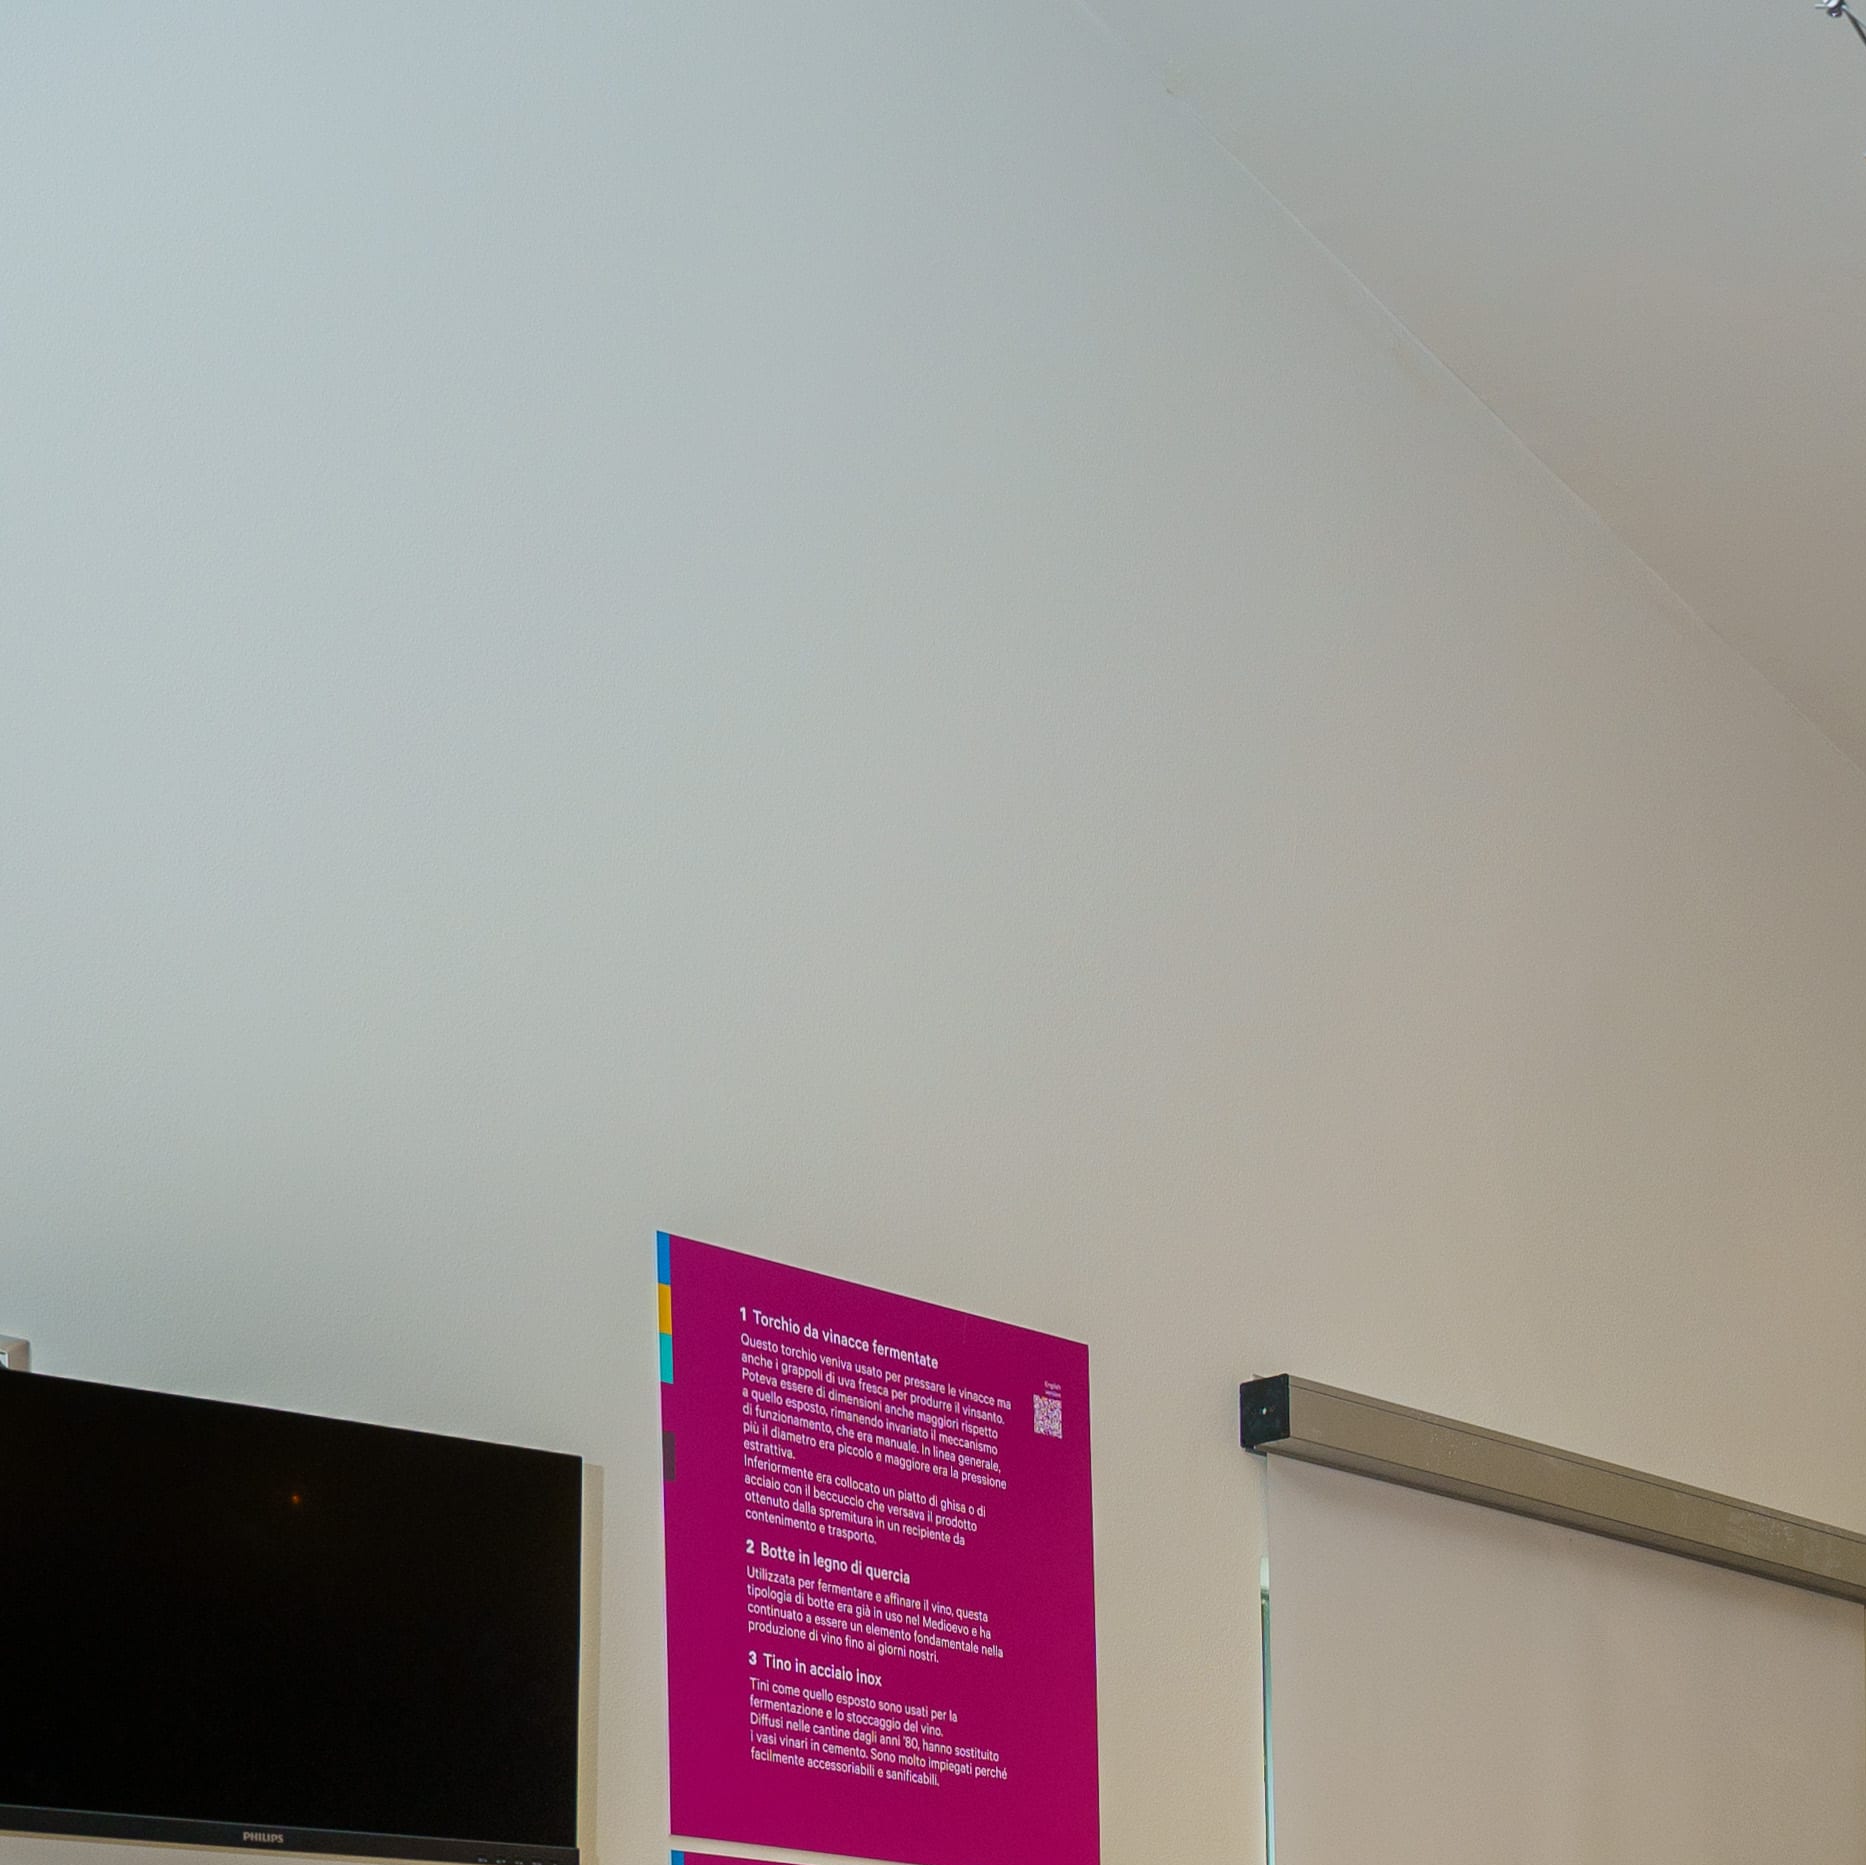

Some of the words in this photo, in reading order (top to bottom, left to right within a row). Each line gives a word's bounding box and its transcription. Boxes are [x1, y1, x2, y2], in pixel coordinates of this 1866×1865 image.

[739, 1304, 746, 1321] 1
[752, 1307, 800, 1334] Torchio
[803, 1320, 818, 1339] da
[821, 1326, 869, 1352] vinacce
[871, 1337, 938, 1369] fermentate
[740, 1332, 778, 1353] Questo
[780, 1343, 817, 1362] torchio
[819, 1355, 852, 1371] veniva
[854, 1364, 882, 1378] usato
[884, 1371, 901, 1383] per
[903, 1375, 945, 1393] pressare
[947, 1382, 956, 1396] le
[958, 1386, 995, 1405] vinacce
[996, 1398, 1011, 1409] ma
[741, 1353, 773, 1368] anche
[780, 1362, 823, 1380] grappoli
[825, 1369, 835, 1383] di
[837, 1376, 855, 1388] uva
[858, 1377, 889, 1396] fresca
[890, 1389, 907, 1401] per
[909, 1393, 952, 1411] produrre
[954, 1400, 960, 1414] il
[961, 1403, 1004, 1424] vinsanto.
[745, 1536, 754, 1553] 2
[760, 1539, 795, 1561] Botte
[798, 1546, 810, 1564] in
[813, 1549, 848, 1573] legno
[850, 1557, 862, 1575] di
[865, 1565, 910, 1585] quercia
[746, 1565, 795, 1585] Utilizzata
[797, 1578, 815, 1590] per
[817, 1578, 873, 1600] fermentare
[883, 1592, 921, 1609] affinare
[923, 1598, 928, 1611] il
[931, 1600, 953, 1617] vino,
[955, 1608, 988, 1622] questa
[748, 1647, 757, 1664] 3
[762, 1650, 791, 1670] Tino
[795, 1655, 806, 1673] in
[809, 1662, 853, 1682] acciaio
[856, 1667, 882, 1687] inox
[749, 1676, 769, 1691] Tini
[771, 1683, 800, 1696] come
[802, 1688, 834, 1702] quello
[835, 1694, 876, 1709] esposto
[878, 1701, 902, 1713] sono
[904, 1705, 928, 1718] usati
[930, 1709, 946, 1722] per
[949, 1709, 957, 1722] la
[243, 1831, 285, 1844] PHILIPS
